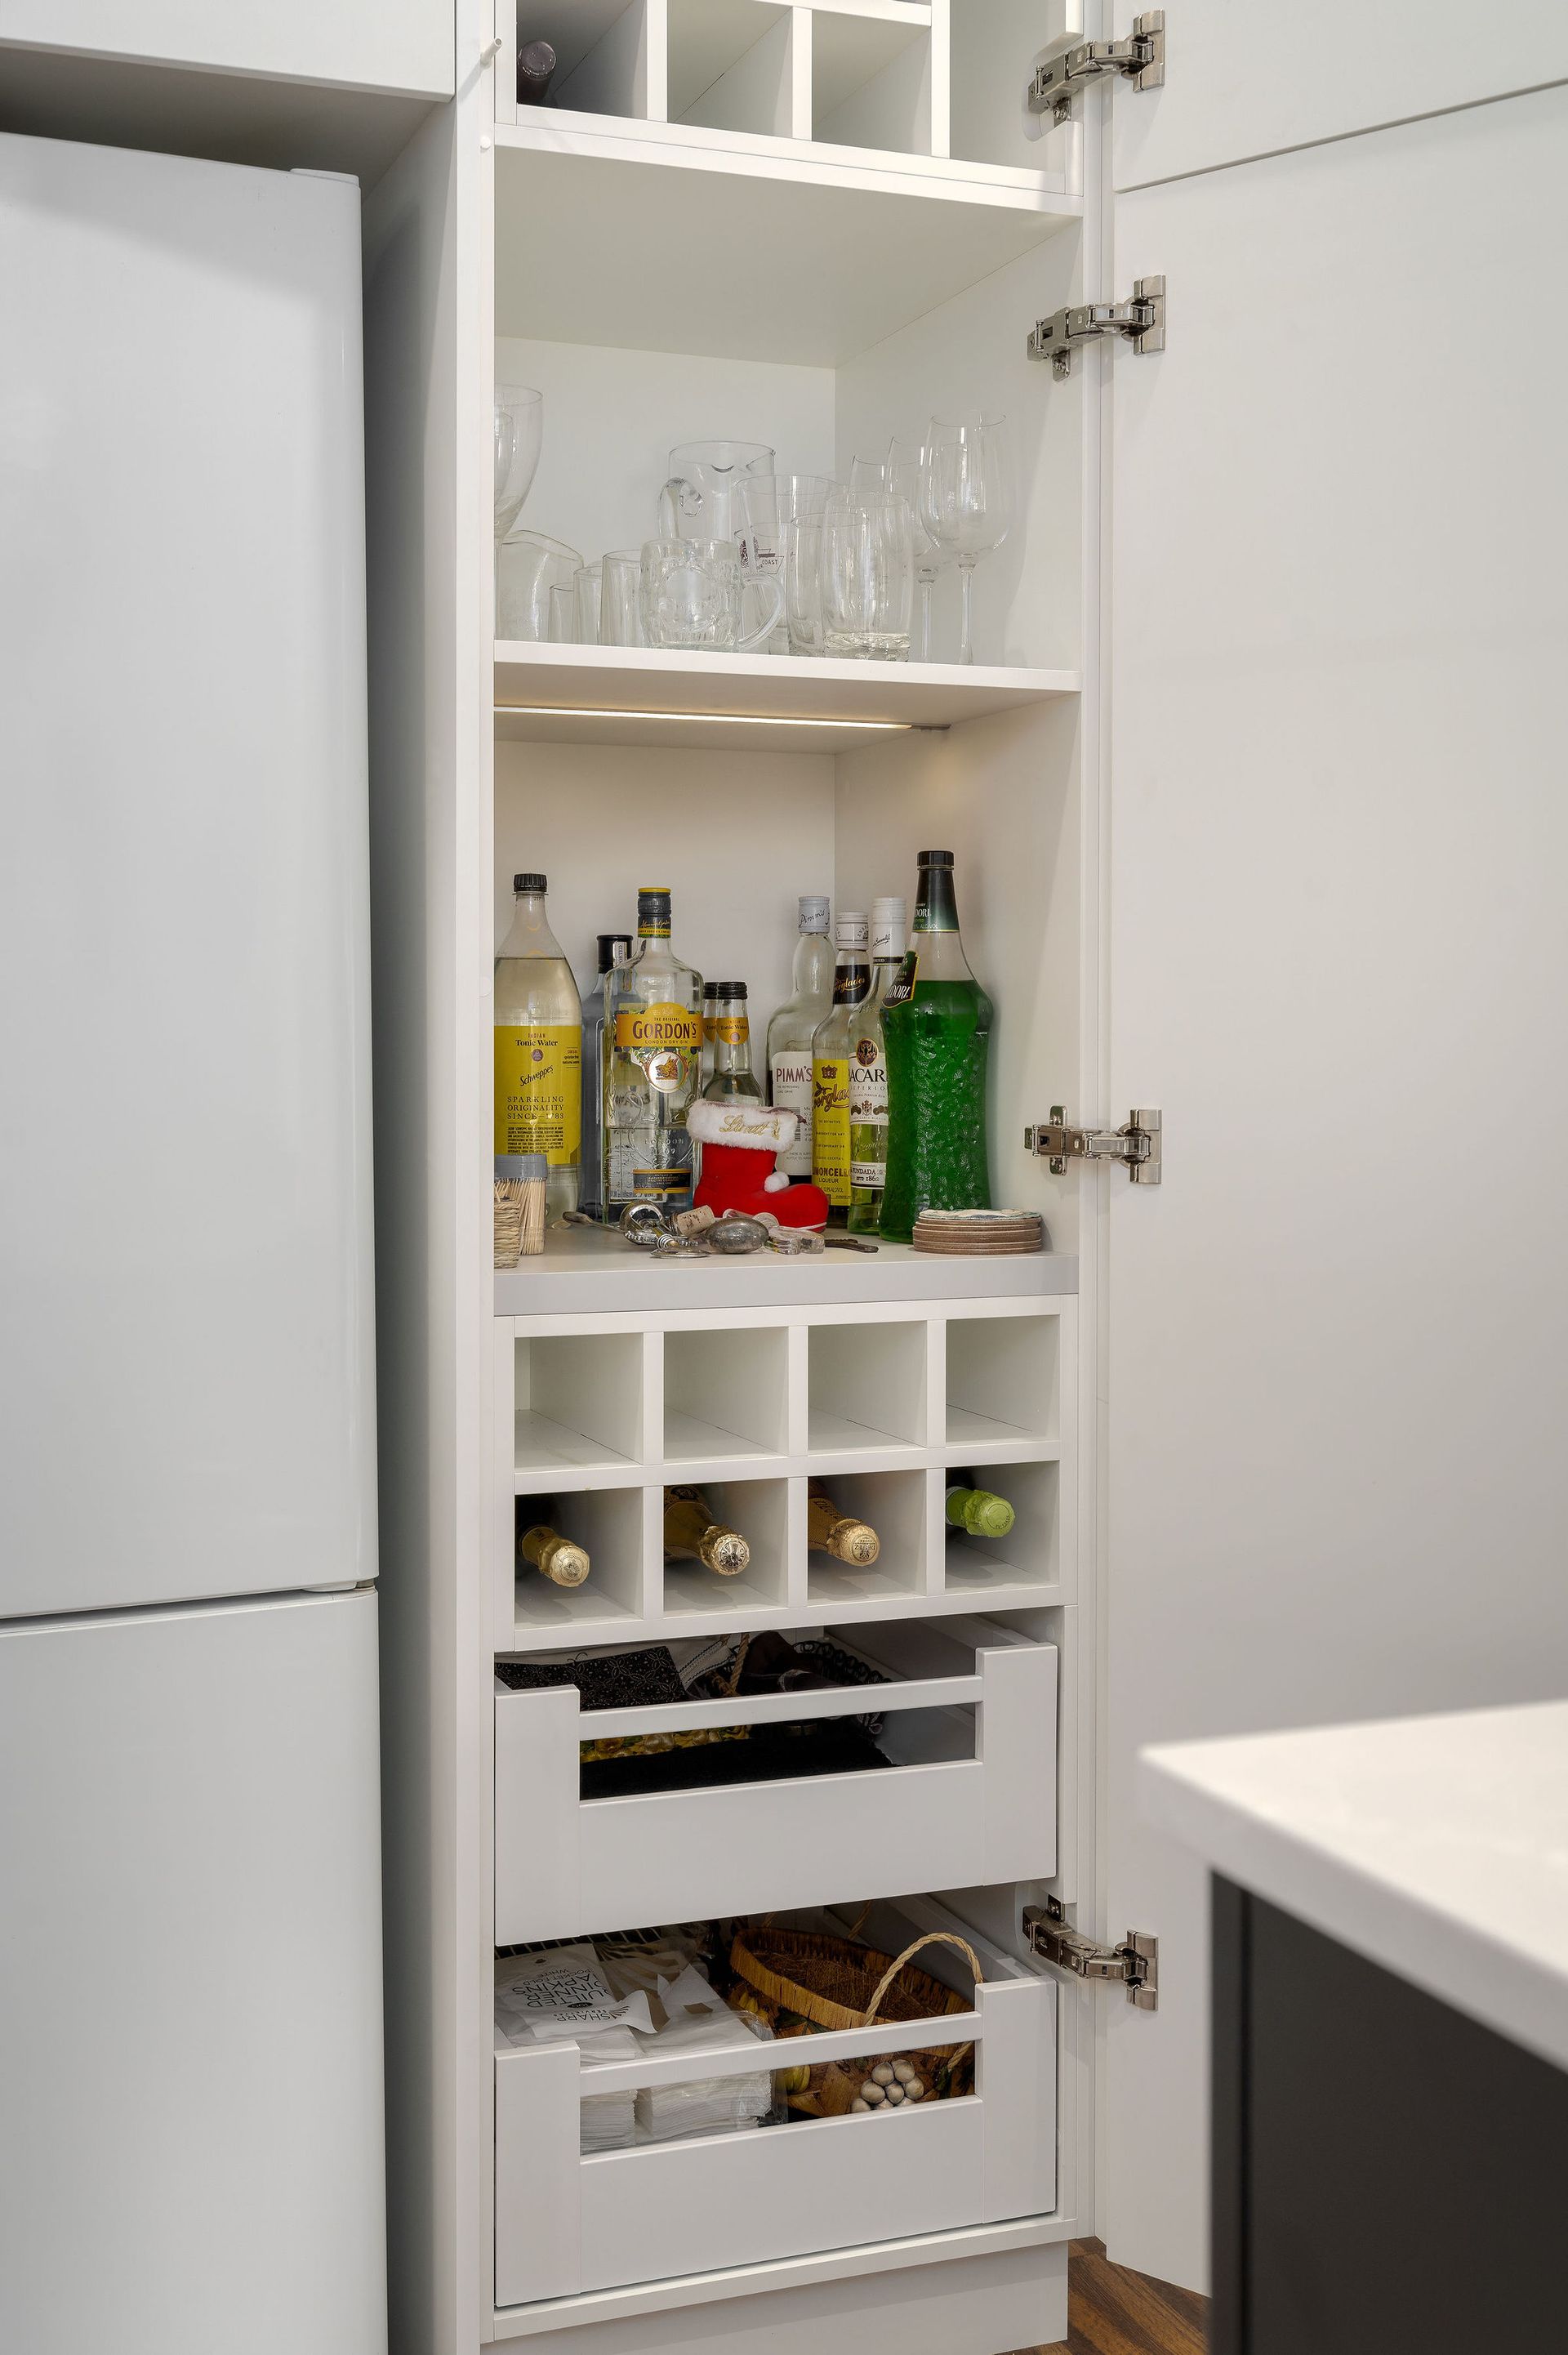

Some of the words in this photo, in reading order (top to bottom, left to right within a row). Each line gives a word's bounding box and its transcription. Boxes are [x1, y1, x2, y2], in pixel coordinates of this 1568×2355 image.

[632, 1020, 698, 1039] GORDON'S
[519, 1064, 555, 1086] Schweppes
[776, 1065, 813, 1082] PIMM'S
[849, 1068, 889, 1083] ACAR
[556, 2012, 611, 2022] SHARP
